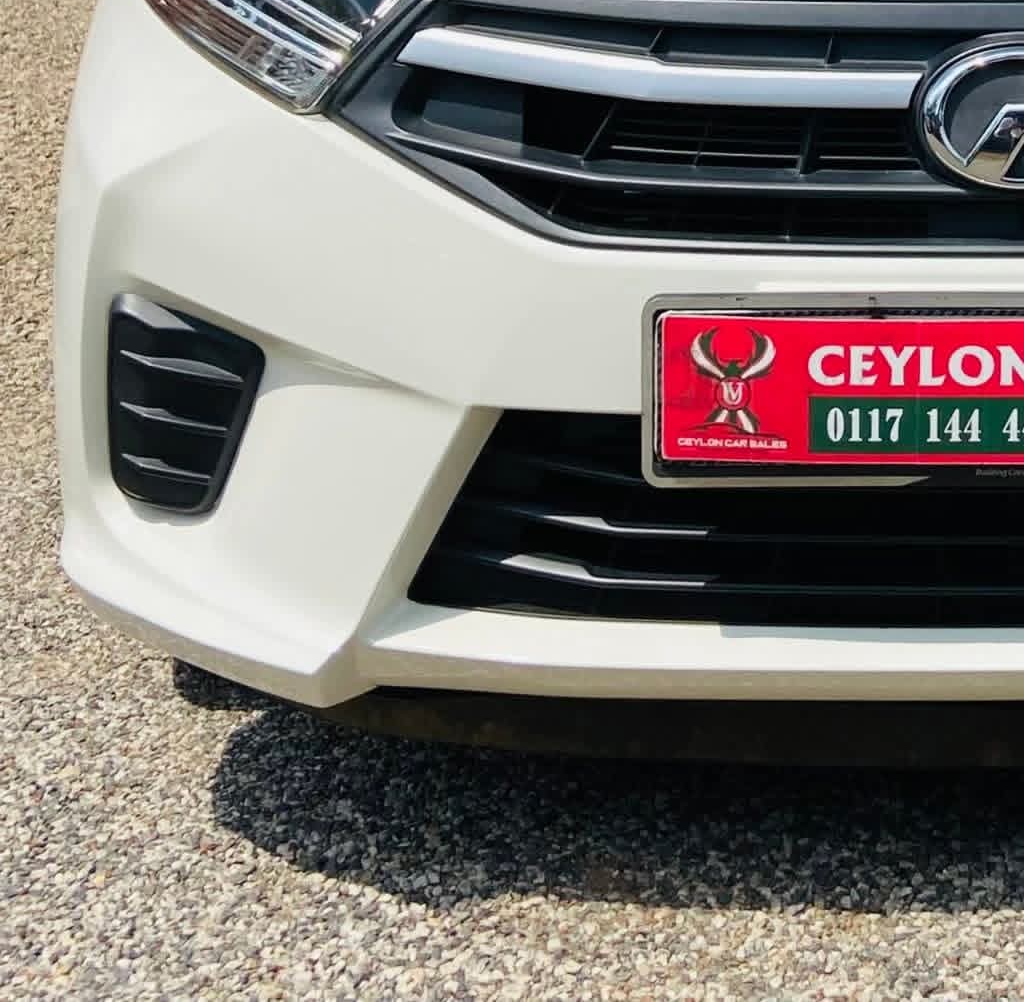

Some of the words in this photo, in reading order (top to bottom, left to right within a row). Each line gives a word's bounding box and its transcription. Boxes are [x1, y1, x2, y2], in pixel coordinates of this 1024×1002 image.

[826, 406, 904, 443] 0117
[926, 407, 982, 443] 144
[677, 437, 723, 448] CEYLON
